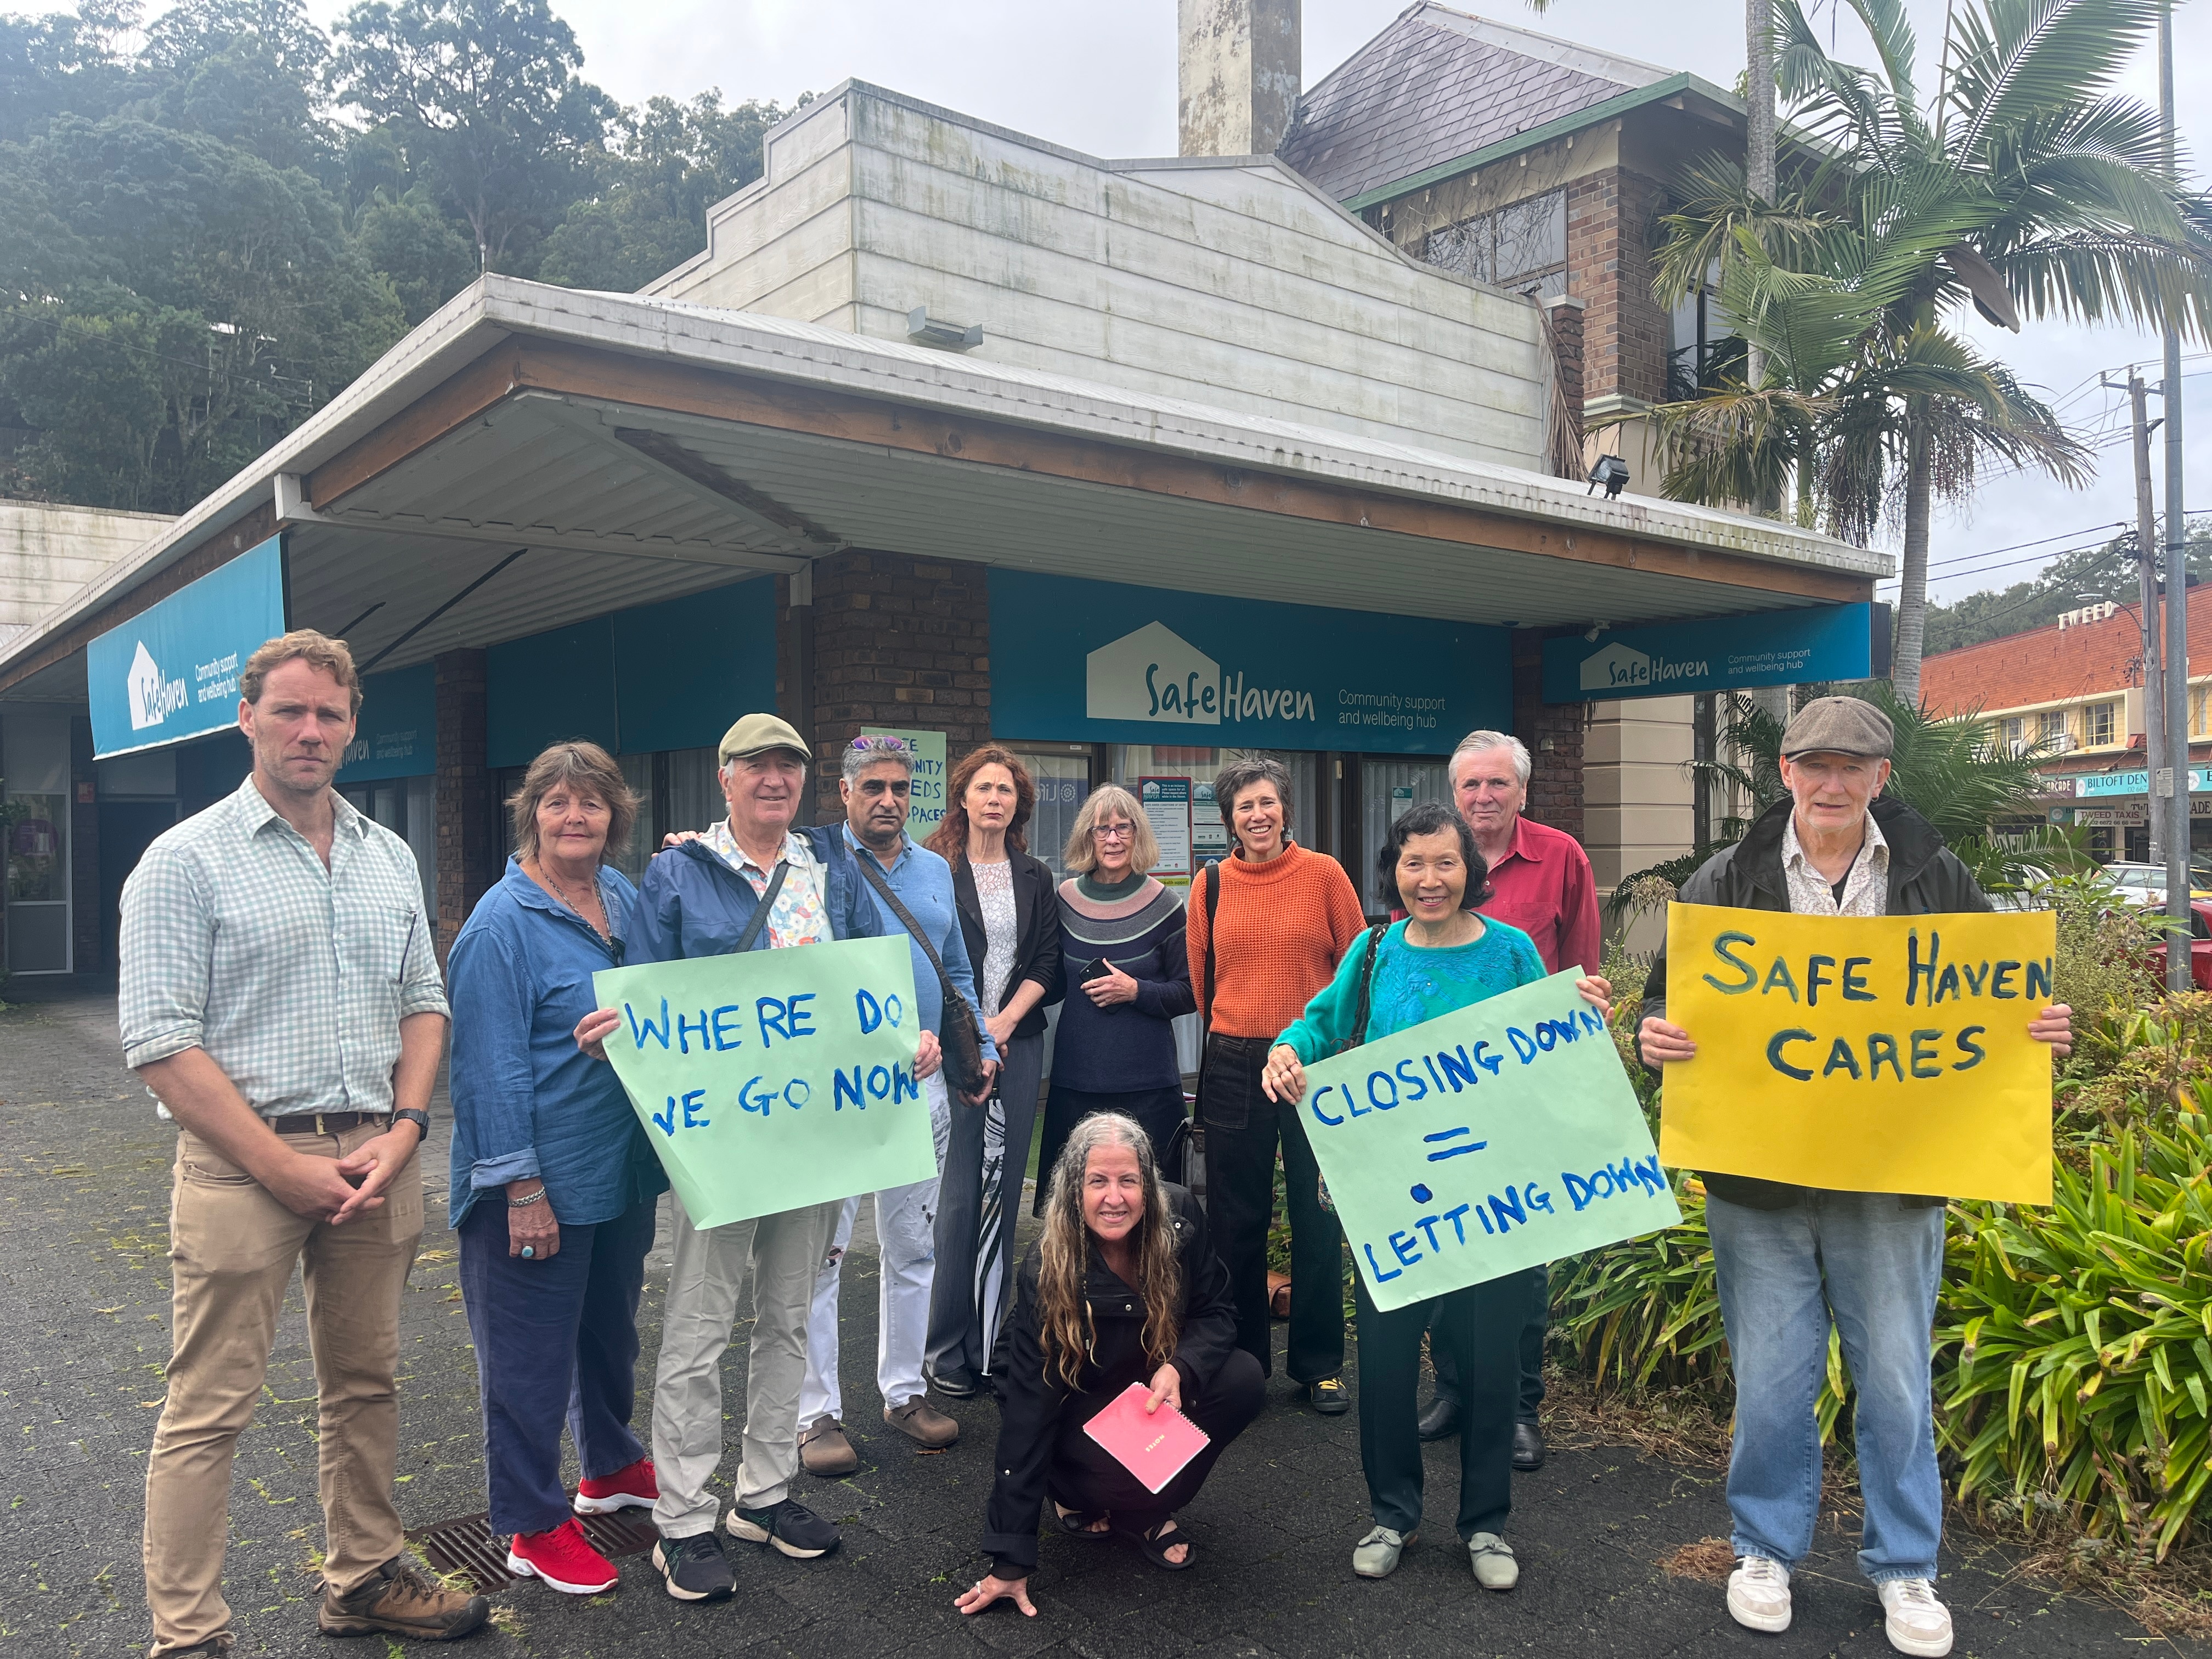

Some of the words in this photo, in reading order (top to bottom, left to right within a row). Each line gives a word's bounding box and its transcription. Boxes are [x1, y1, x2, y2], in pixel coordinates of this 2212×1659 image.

[2057, 600, 2115, 630] TWEED
[195, 657, 220, 682] Community
[220, 650, 238, 674] support
[1728, 652, 1775, 664] Community
[1777, 648, 1811, 661] support
[1728, 665, 1743, 674] and
[1745, 662, 1784, 672] wellbeing
[1786, 659, 1803, 669] hub
[1609, 661, 1648, 686] Safe
[1651, 657, 1709, 682] Haven
[142, 676, 161, 723] Safe
[160, 669, 188, 718] Haven
[198, 684, 207, 703] and
[206, 678, 227, 699] wellbeing
[226, 674, 236, 693] hub
[1146, 663, 1216, 719] Safe
[1224, 671, 1316, 722] Haven
[1339, 689, 1403, 711] Community
[1405, 697, 1446, 712] support
[1339, 710, 1360, 725] and
[1363, 711, 1414, 730] wellbeing
[1416, 713, 1436, 728] hub
[2087, 776, 2124, 788] BILTOFT
[907, 805, 947, 823] PACES
[1702, 930, 1878, 1006] SAFE
[1905, 927, 2053, 1007] HAVEN
[624, 994, 816, 1054] WHERE
[855, 989, 903, 1035] DO
[1311, 1041, 1503, 1126] CLOSING
[1506, 1006, 1604, 1065] DOWN
[1767, 1025, 1987, 1082] CARES
[738, 1076, 811, 1116] GO
[834, 1061, 919, 1111] NOW
[1363, 1182, 1555, 1283] LETTING
[1562, 1155, 1666, 1211] DOWN
[1145, 1434, 1165, 1452] NOTES
